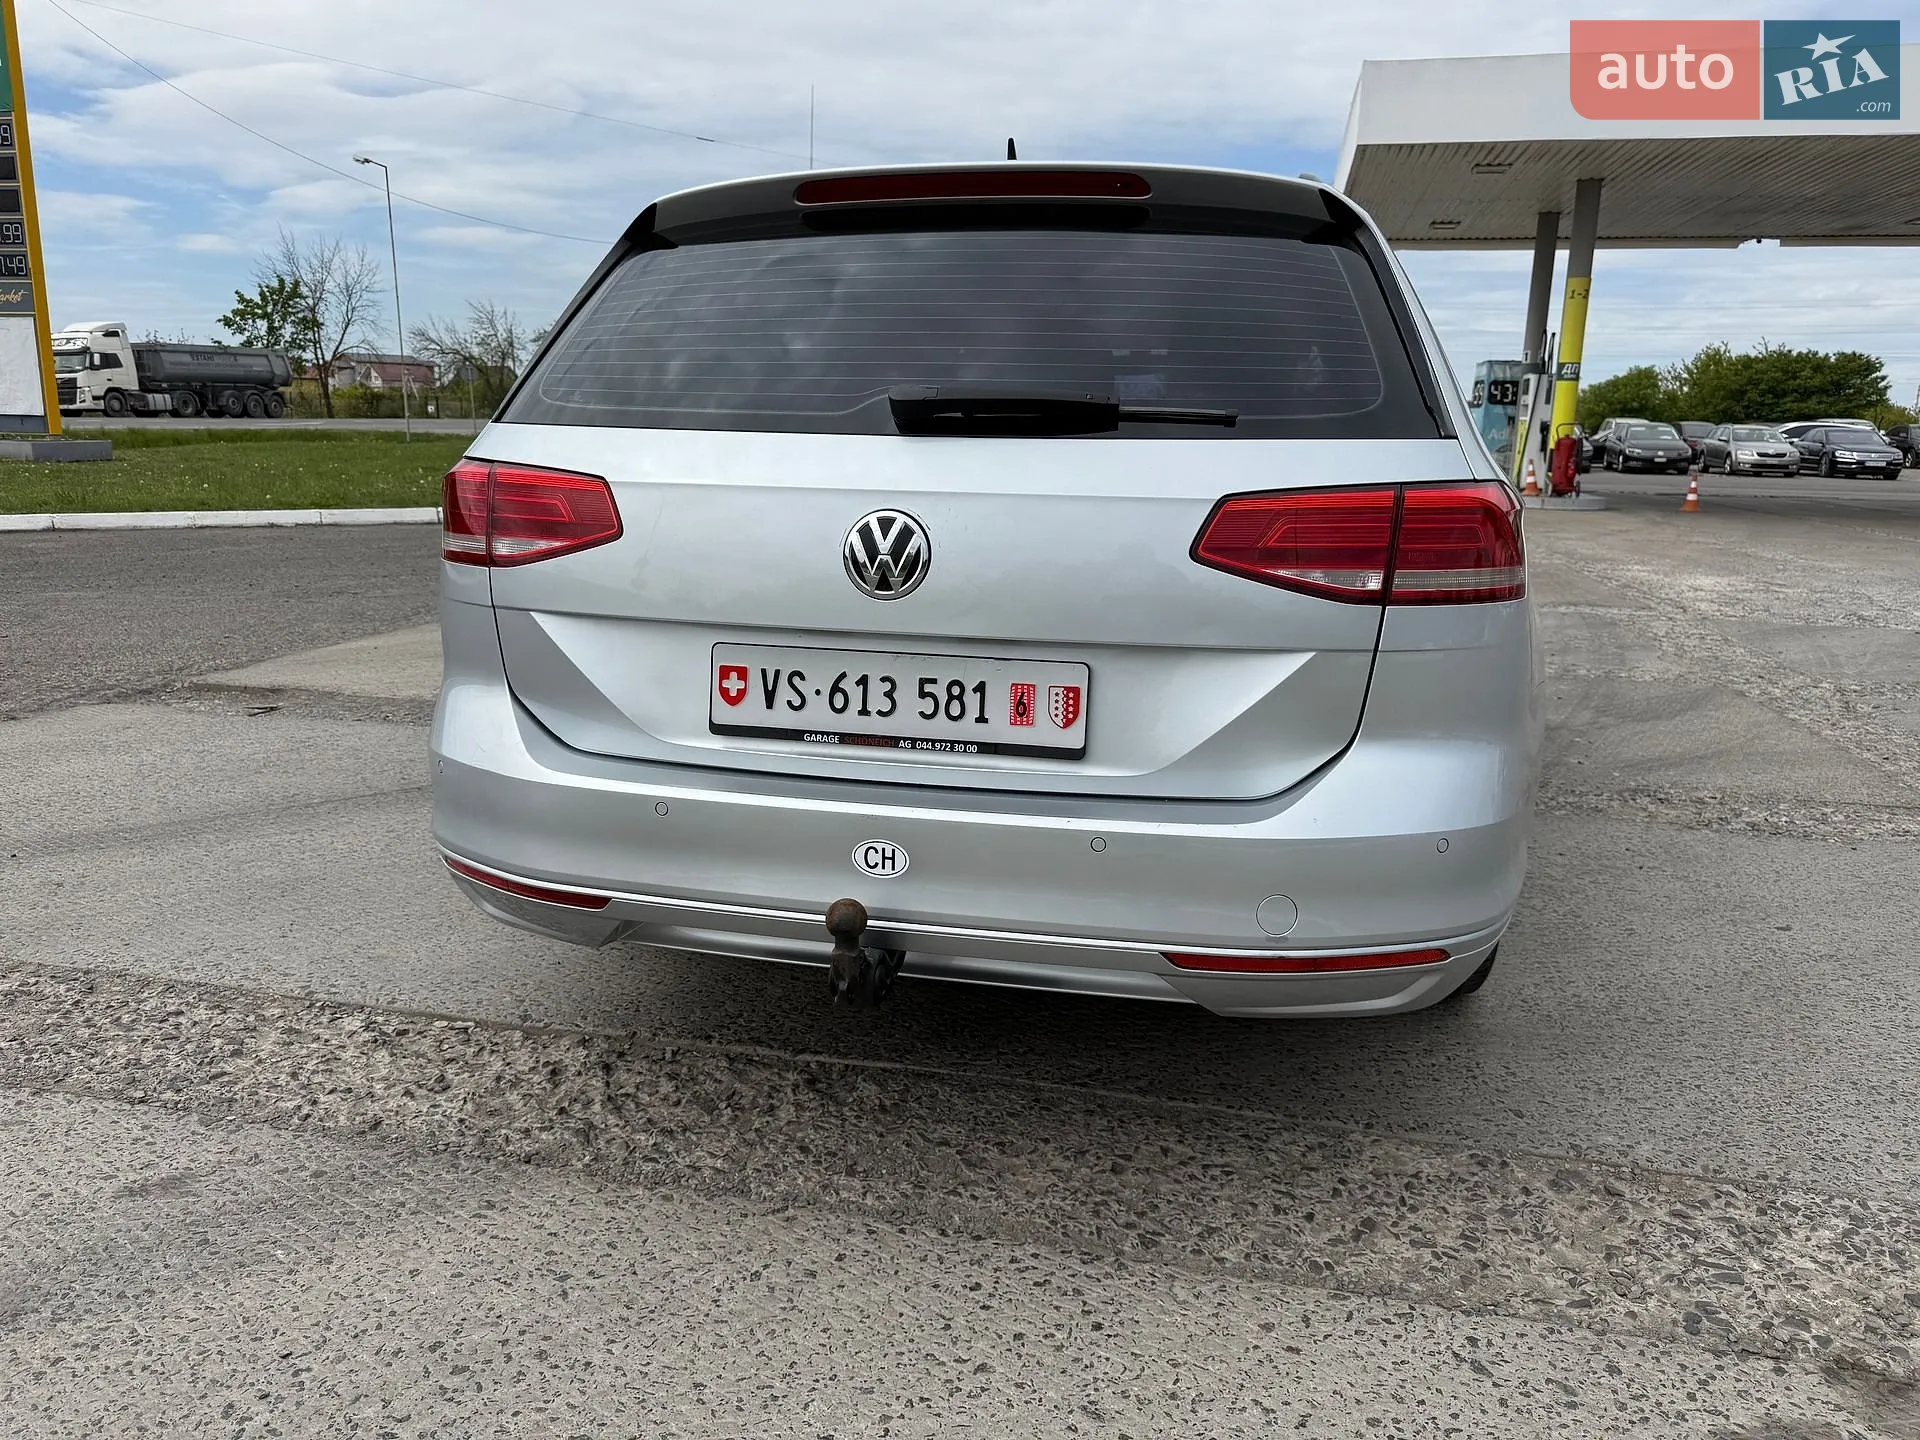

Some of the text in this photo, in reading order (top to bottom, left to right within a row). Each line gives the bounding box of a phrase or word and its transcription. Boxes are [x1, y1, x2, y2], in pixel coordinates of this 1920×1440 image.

[0, 288, 30, 304] arket
[918, 677, 989, 724] 581
[804, 733, 840, 744] GARAGE
[898, 739, 912, 749] AG
[916, 741, 951, 752] 044.972
[953, 743, 965, 753] 30
[966, 744, 978, 753] 00
[864, 846, 896, 871] CH
